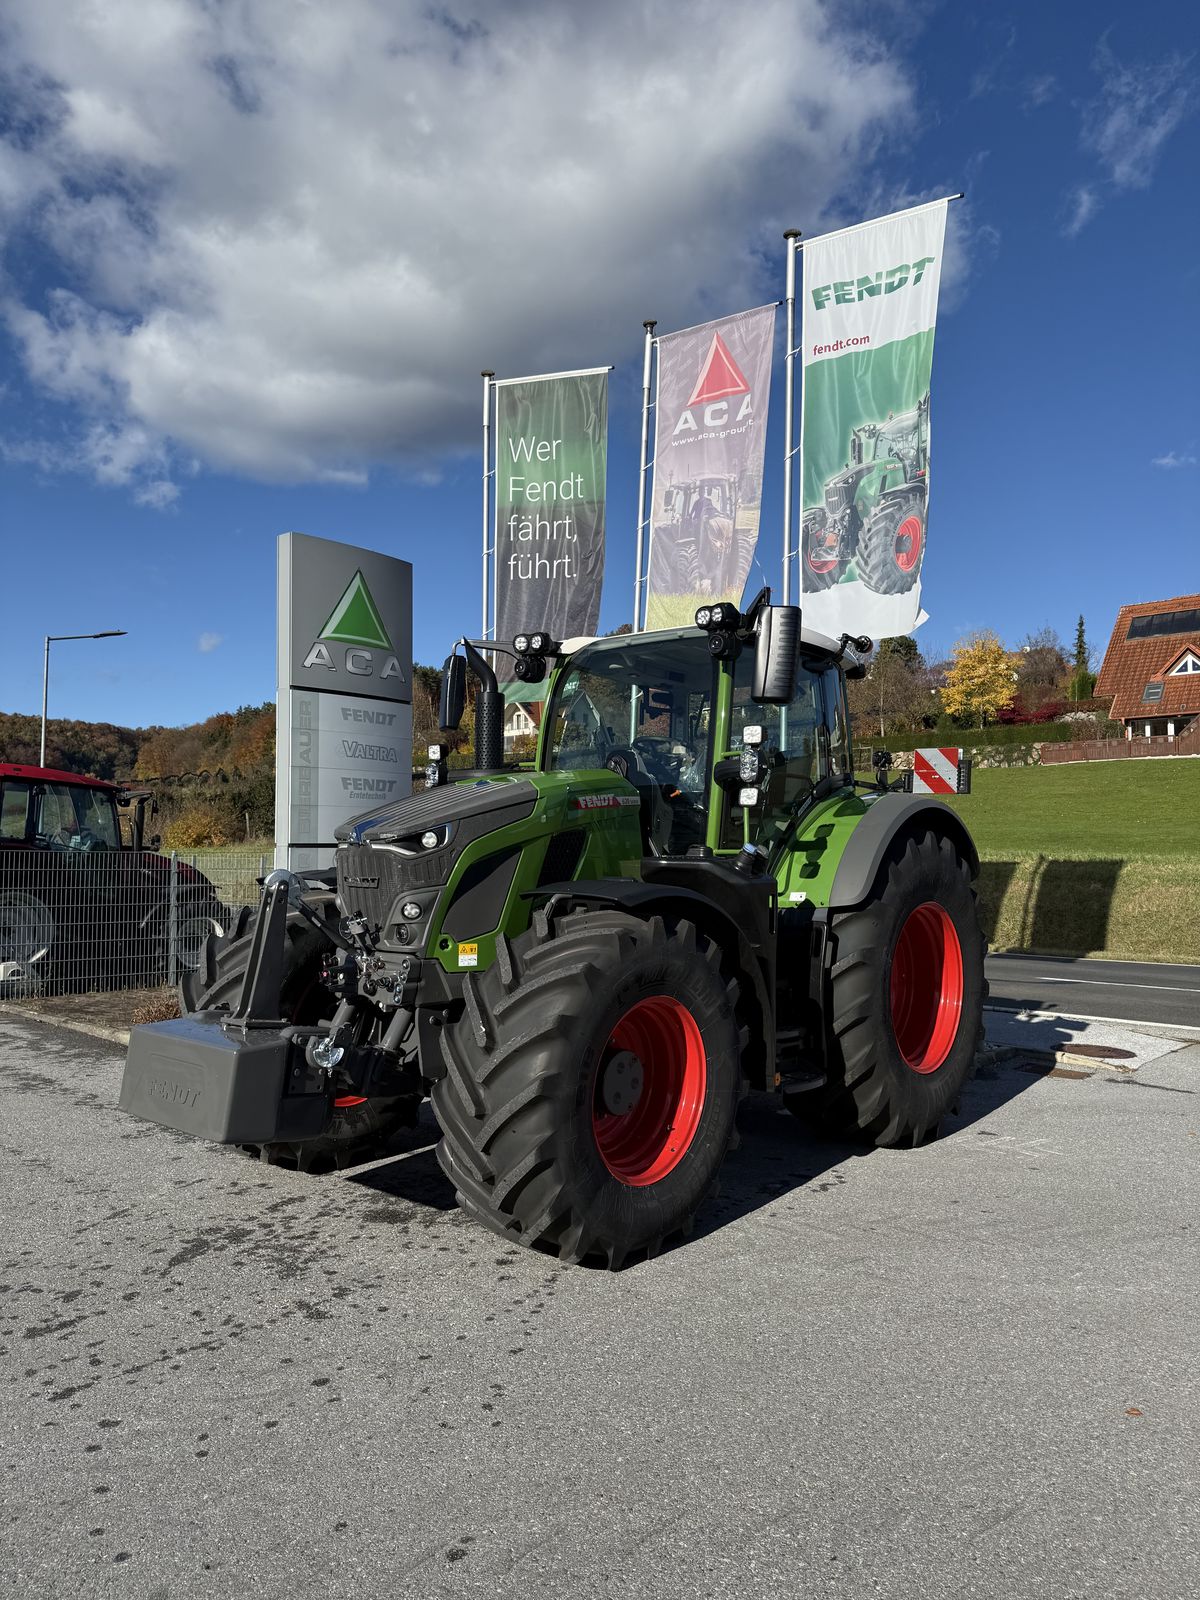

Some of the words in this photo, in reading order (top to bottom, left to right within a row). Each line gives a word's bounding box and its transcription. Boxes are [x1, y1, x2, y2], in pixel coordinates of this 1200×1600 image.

[811, 256, 935, 310] FENDT
[813, 335, 869, 356] fendt.com
[672, 393, 753, 435] ACA
[508, 436, 561, 462] Wer
[509, 471, 584, 502] Fendt
[508, 514, 577, 542] fährt,
[508, 552, 577, 581] führt.
[302, 641, 406, 683] ACA
[341, 707, 397, 726] FENDT
[341, 776, 397, 793] FENDT
[579, 794, 615, 808] FENDT
